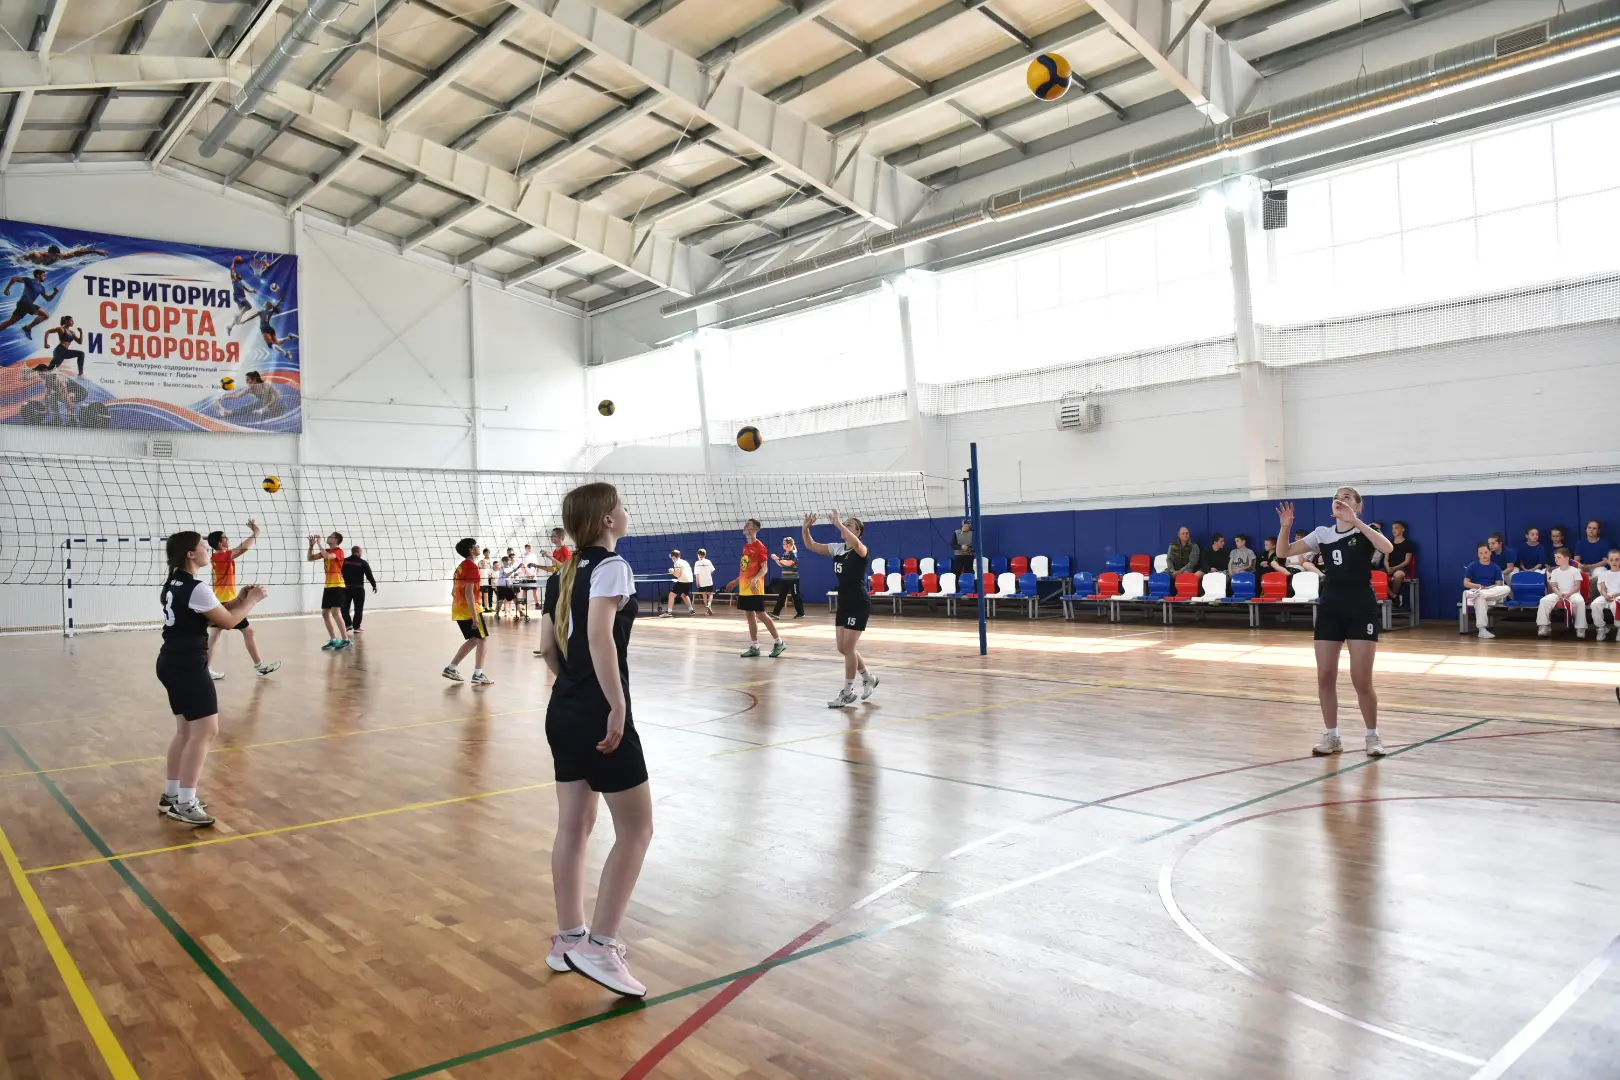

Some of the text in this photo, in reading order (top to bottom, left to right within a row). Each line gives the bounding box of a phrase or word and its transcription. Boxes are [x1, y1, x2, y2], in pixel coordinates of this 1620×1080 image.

[83, 275, 231, 308] ТЕРРИТОРИЯ
[100, 301, 216, 337] СПОРТА
[88, 332, 240, 363] И ЗДОРОВЬЯ
[1332, 549, 1343, 566] 9
[834, 561, 843, 574] 15
[847, 617, 856, 626] 15
[1366, 623, 1374, 635] 9
